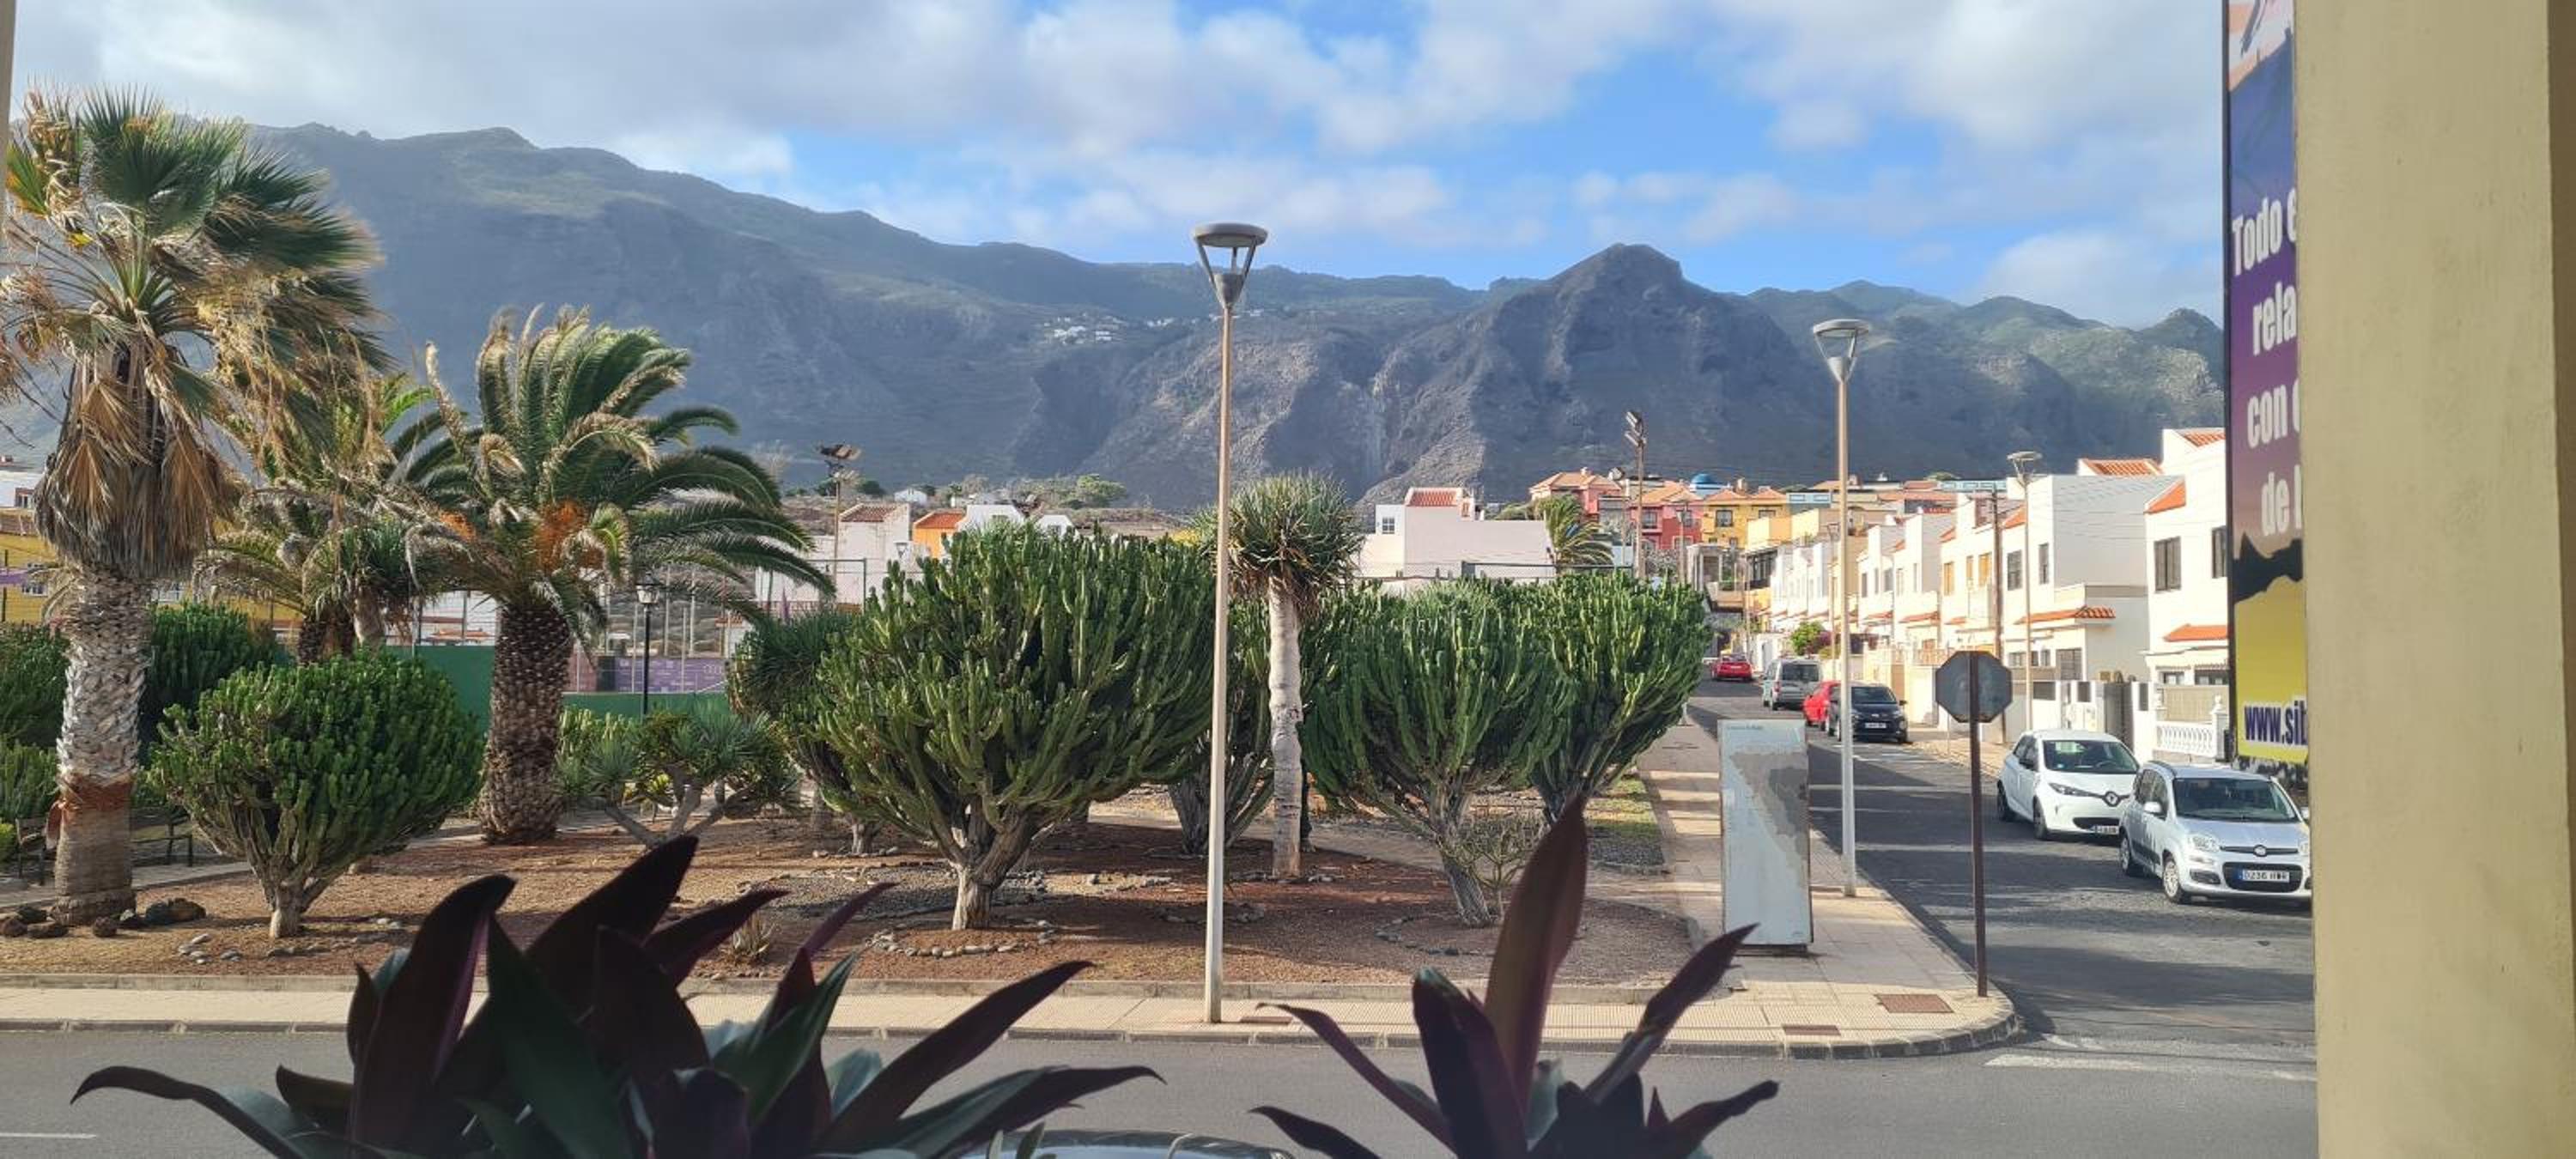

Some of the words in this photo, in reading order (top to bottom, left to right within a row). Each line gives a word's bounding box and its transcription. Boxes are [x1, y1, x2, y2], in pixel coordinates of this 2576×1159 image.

[2232, 197, 2283, 276] Todo
[2253, 281, 2297, 357] rela
[2247, 385, 2287, 448] con
[2261, 472, 2290, 536] de
